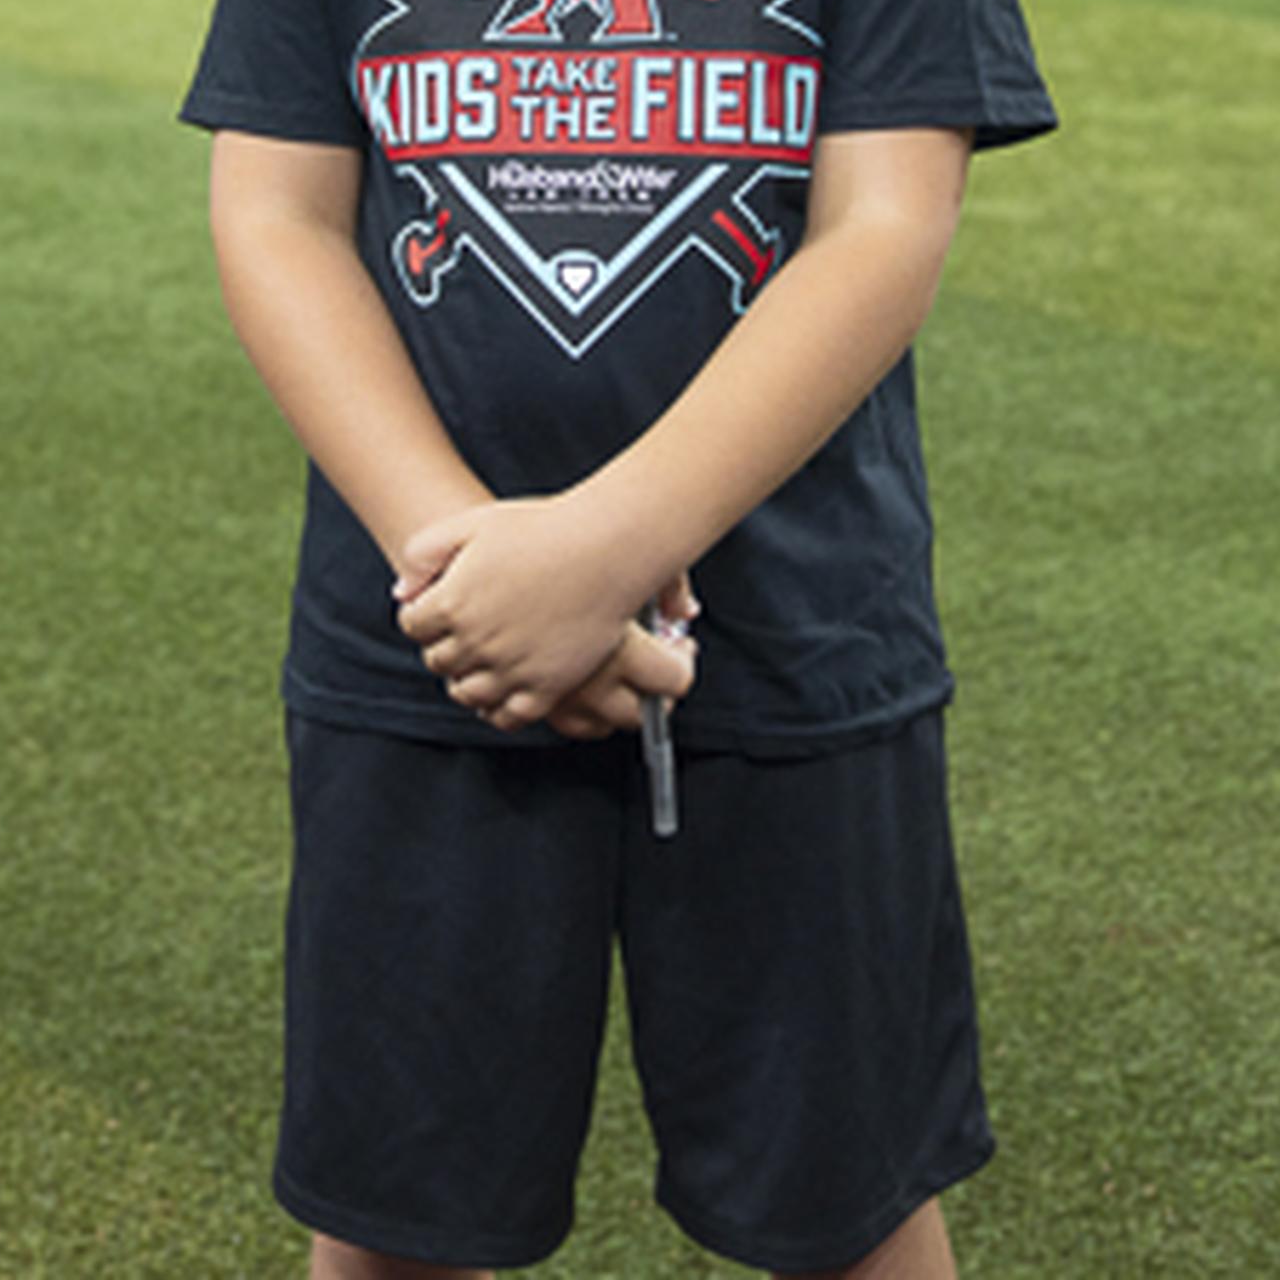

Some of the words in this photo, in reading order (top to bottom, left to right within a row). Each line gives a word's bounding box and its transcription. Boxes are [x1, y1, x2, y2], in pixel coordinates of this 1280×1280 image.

[363, 56, 497, 147] KIDS
[511, 56, 617, 93] TAKE
[631, 56, 817, 149] FIELD
[510, 95, 616, 140] THE
